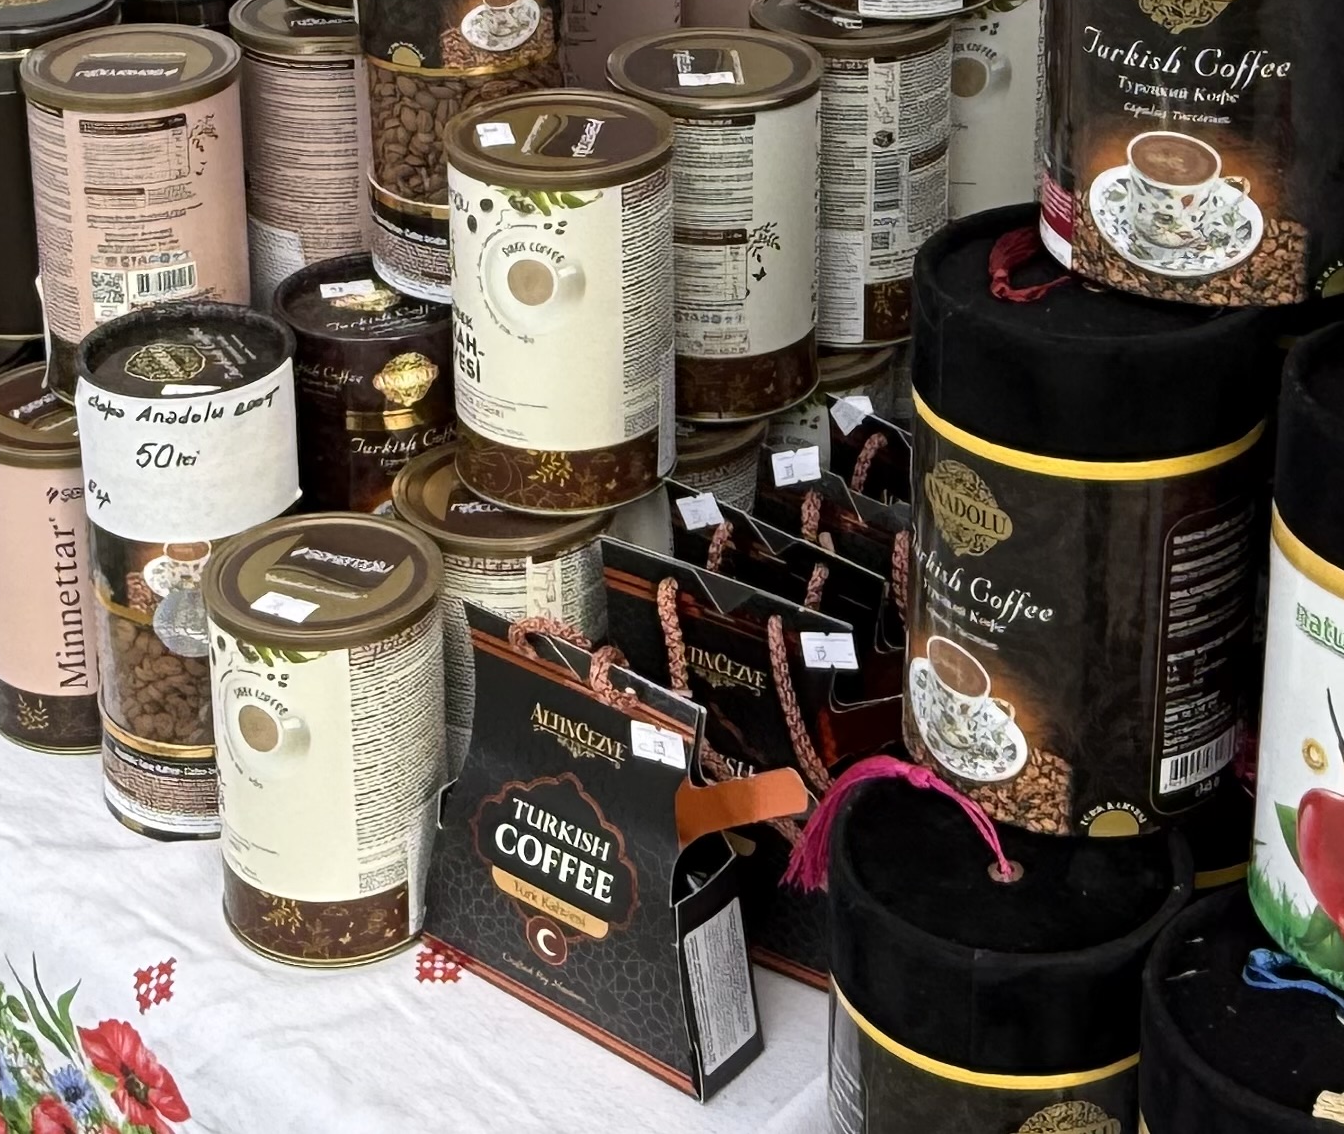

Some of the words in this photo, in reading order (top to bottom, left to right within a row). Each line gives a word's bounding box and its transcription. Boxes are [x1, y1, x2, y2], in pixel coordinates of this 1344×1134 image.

[1082, 26, 1187, 74] Turkish
[1194, 48, 1292, 90] Coffee
[136, 401, 224, 424] Anadolu
[50, 516, 89, 690] Minnettar
[970, 576, 1054, 624] Coffee
[512, 797, 612, 862] TURKISH
[494, 823, 616, 904] COFFEE
